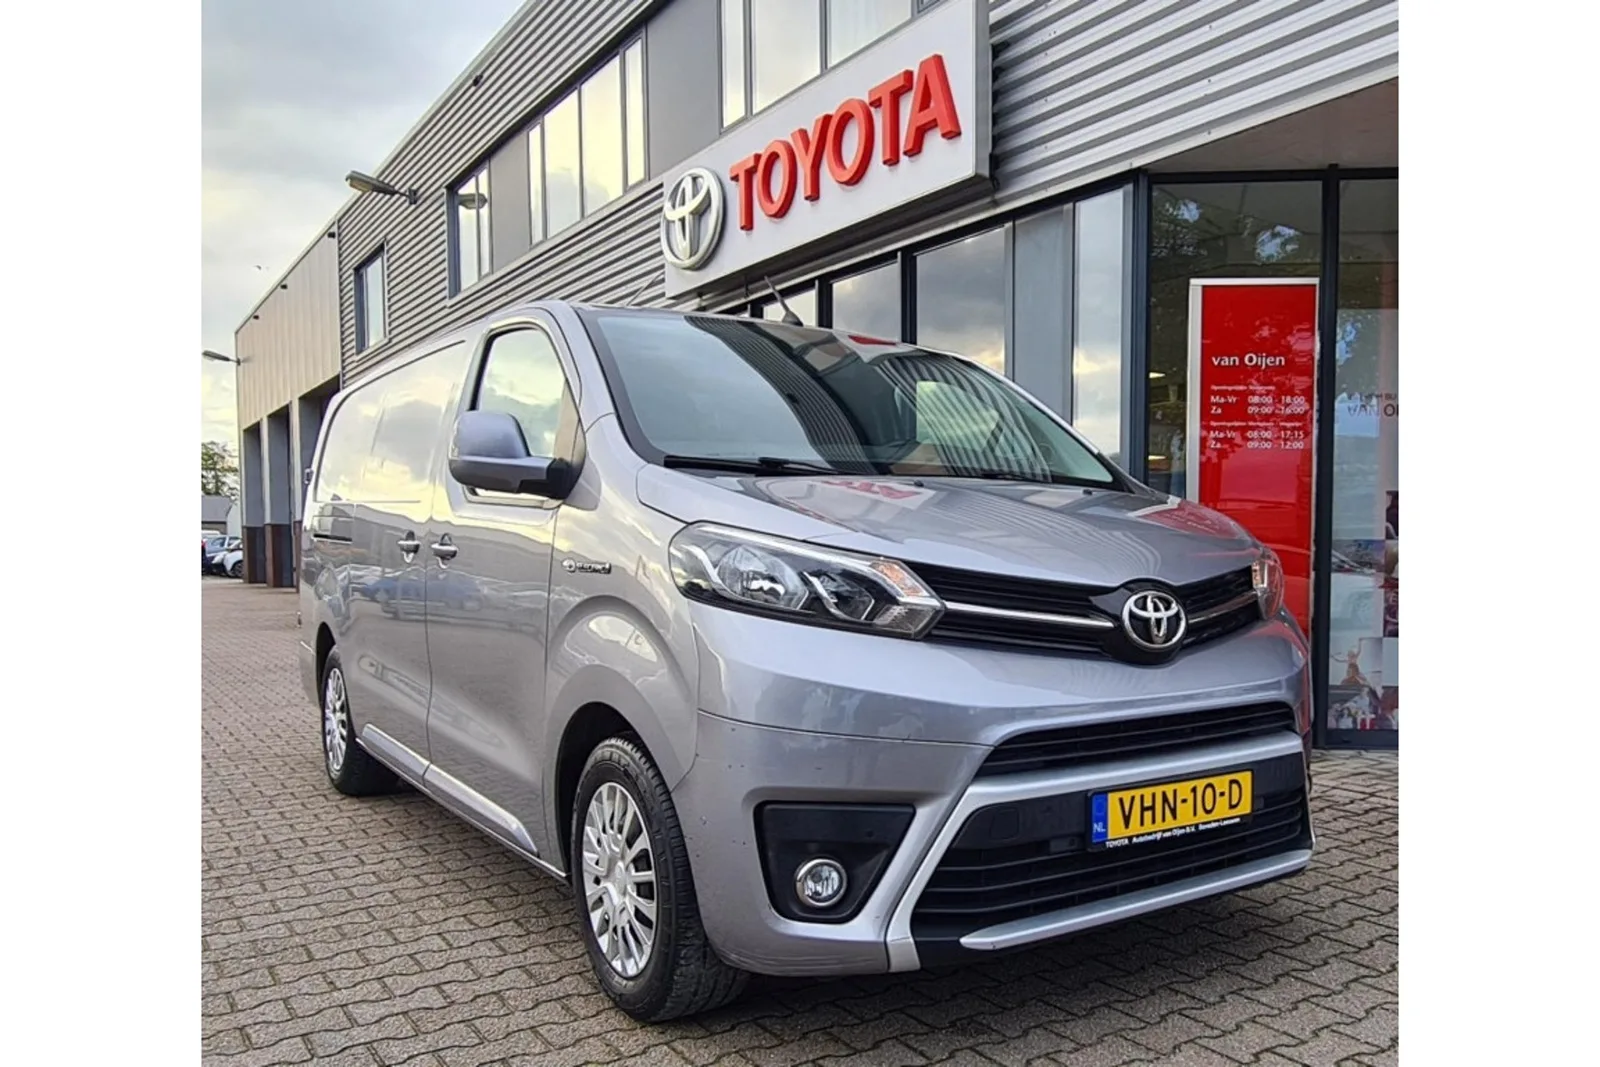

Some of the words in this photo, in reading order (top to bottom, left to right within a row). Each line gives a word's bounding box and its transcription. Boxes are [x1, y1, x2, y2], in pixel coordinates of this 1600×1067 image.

[730, 54, 962, 231] TOYOTA
[1211, 356, 1240, 366] van
[1244, 353, 1286, 370] Oijen
[1210, 395, 1237, 404] Ma-Vr
[1247, 395, 1273, 404] 08:00
[1281, 395, 1305, 404] 18:00
[1210, 406, 1222, 414] Za
[1247, 406, 1273, 414] 09:00
[1281, 430, 1304, 438] 17:15
[1210, 441, 1221, 449] Za
[1246, 441, 1272, 449] 09:00
[1281, 441, 1304, 449] 12:00
[1118, 779, 1243, 830] VHN-10-D
[1093, 821, 1107, 833] NL
[1105, 838, 1129, 848] TOYOTA
